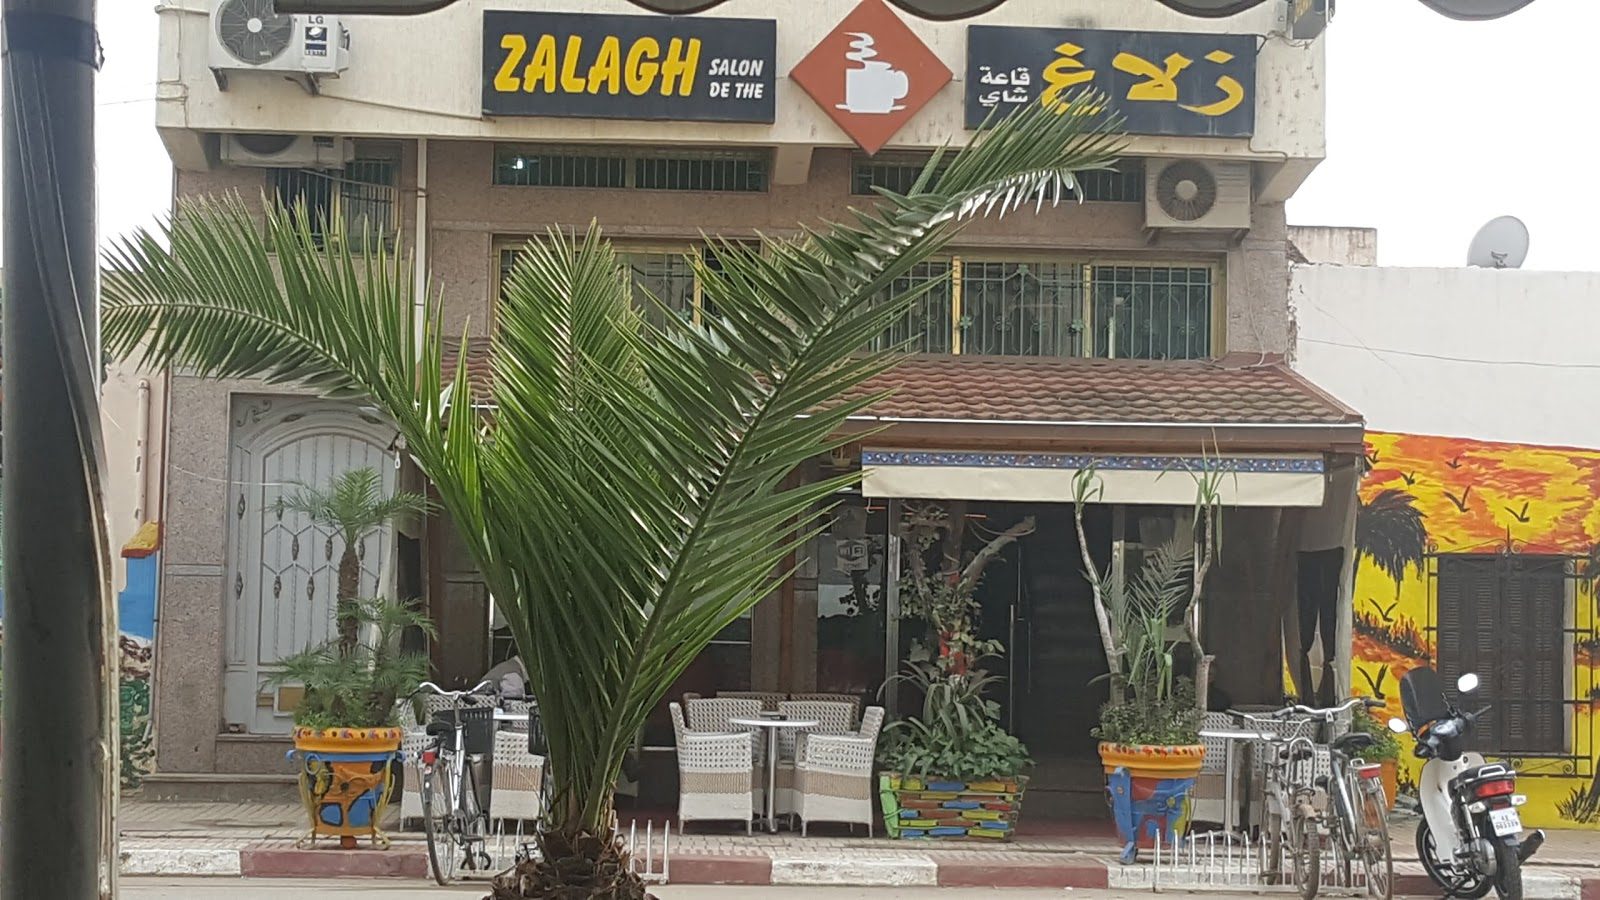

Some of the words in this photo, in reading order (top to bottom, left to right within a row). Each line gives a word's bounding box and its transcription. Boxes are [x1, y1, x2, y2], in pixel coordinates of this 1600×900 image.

[308, 15, 324, 25] LG
[493, 33, 703, 97] ZALAGH
[708, 58, 764, 77] SALON
[979, 66, 1031, 86] قاعة
[1042, 42, 1245, 117] زلاغ
[709, 81, 731, 98] DE
[734, 82, 765, 99] THE
[978, 86, 1029, 107] شاي
